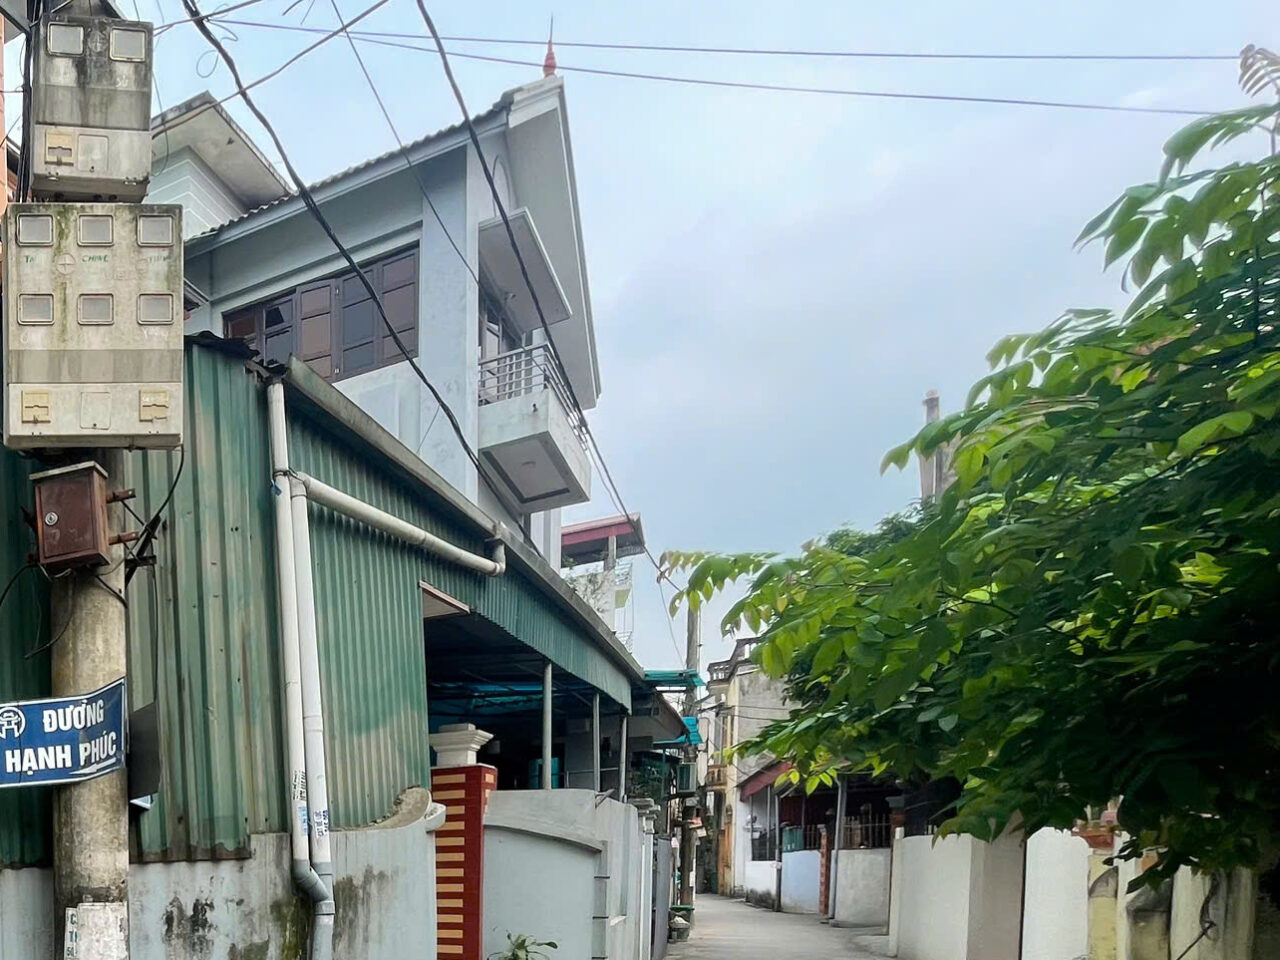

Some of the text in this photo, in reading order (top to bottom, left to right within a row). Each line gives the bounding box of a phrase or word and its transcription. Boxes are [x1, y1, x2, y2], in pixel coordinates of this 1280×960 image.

[42, 699, 105, 733] ĐƯỜNG
[5, 730, 117, 776] HẠNH PHÚC
